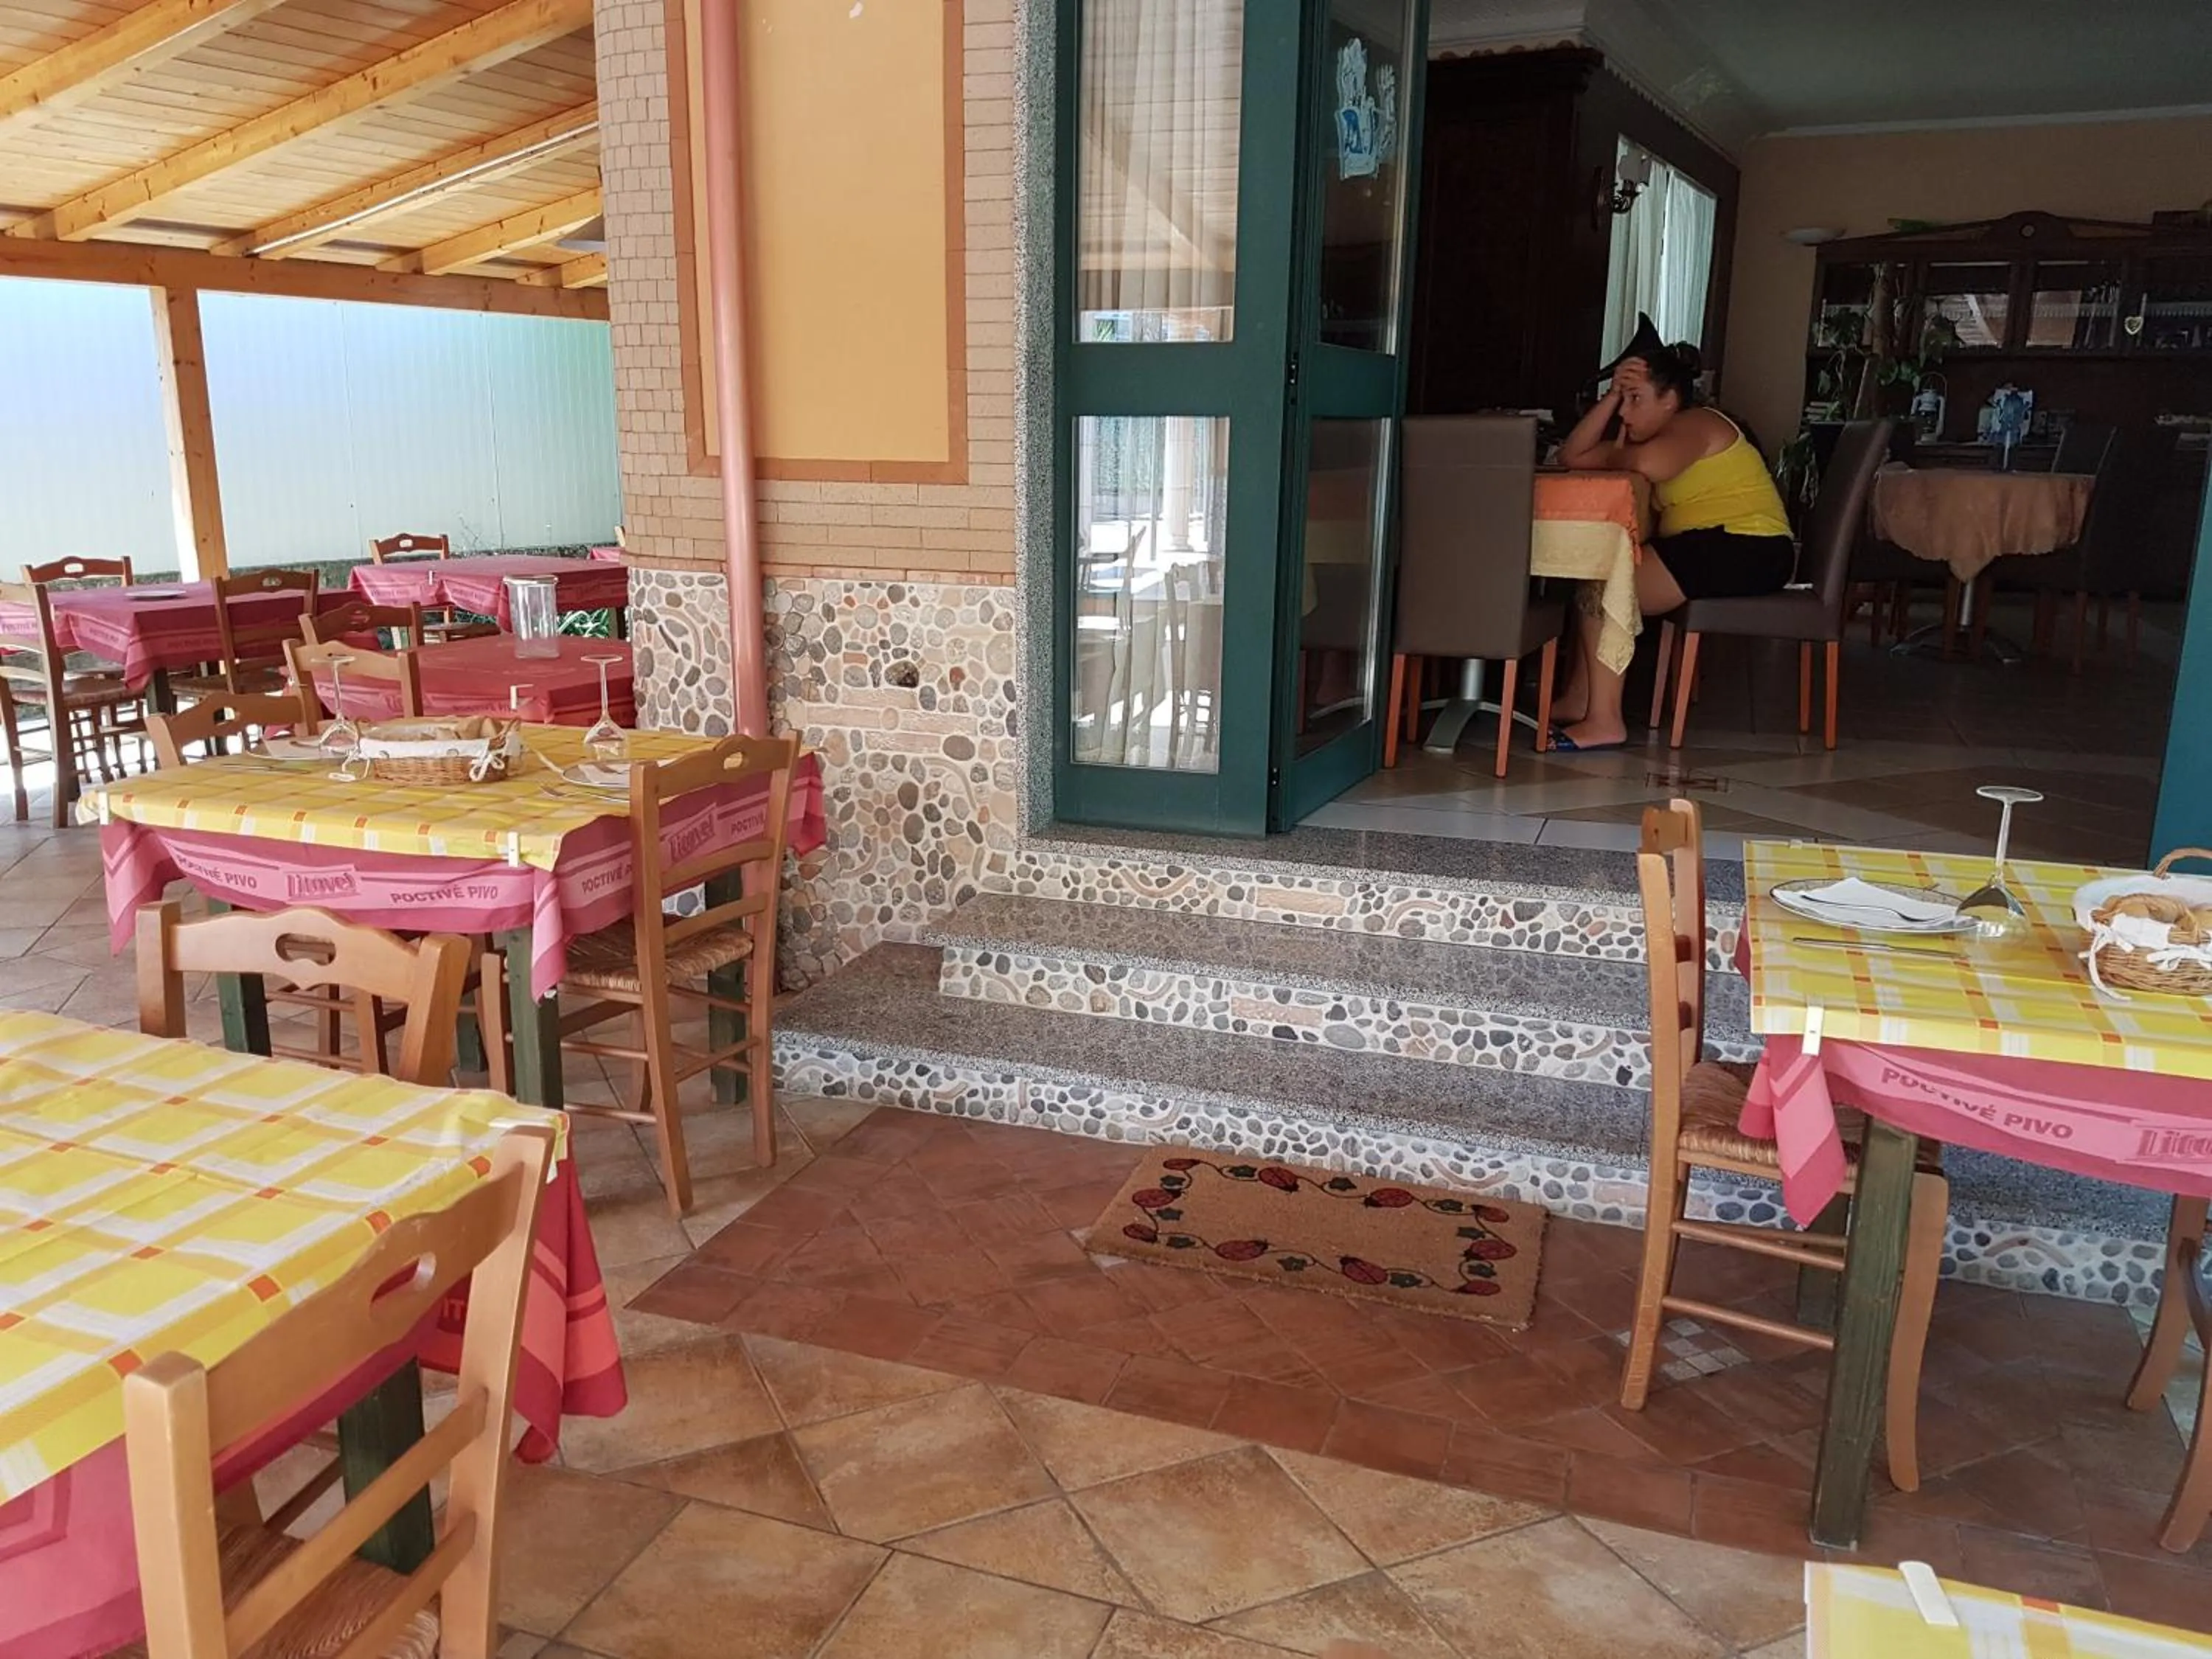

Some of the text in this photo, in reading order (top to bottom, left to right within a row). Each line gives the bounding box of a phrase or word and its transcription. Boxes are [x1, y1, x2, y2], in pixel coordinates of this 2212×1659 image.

[224, 872, 257, 888] PIVO
[390, 884, 465, 903] POCTIVÉ
[467, 886, 498, 900] PIVO
[2003, 1113, 2073, 1139] PIVO
